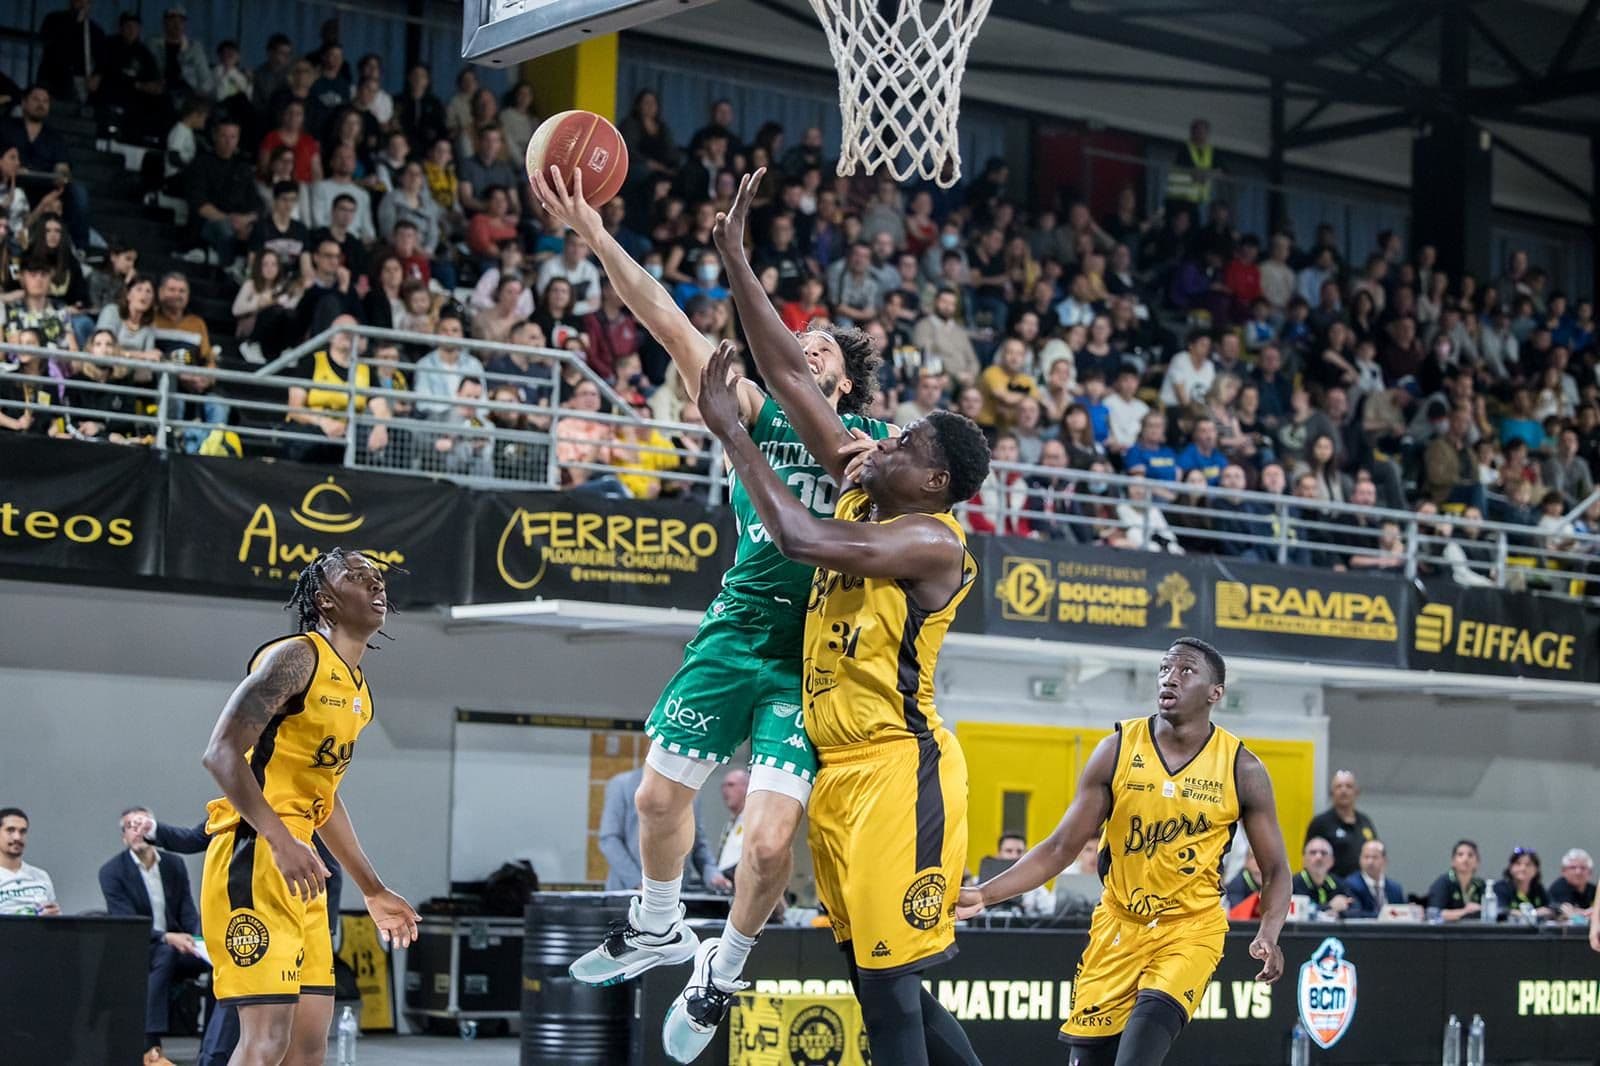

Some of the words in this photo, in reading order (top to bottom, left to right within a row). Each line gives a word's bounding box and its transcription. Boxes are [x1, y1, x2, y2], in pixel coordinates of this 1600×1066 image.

[520, 509, 718, 558] FERRERO
[1058, 602, 1085, 623] DU
[1250, 584, 1396, 624] RAMPA
[1456, 621, 1575, 670] EIFFAGE
[1123, 811, 1212, 860] Byers
[1176, 847, 1196, 875] 2
[938, 980, 1054, 1020] MATCH
[1231, 980, 1273, 1019] VS
[1310, 986, 1346, 1010] BCM
[1518, 980, 1600, 1016] PROCH
